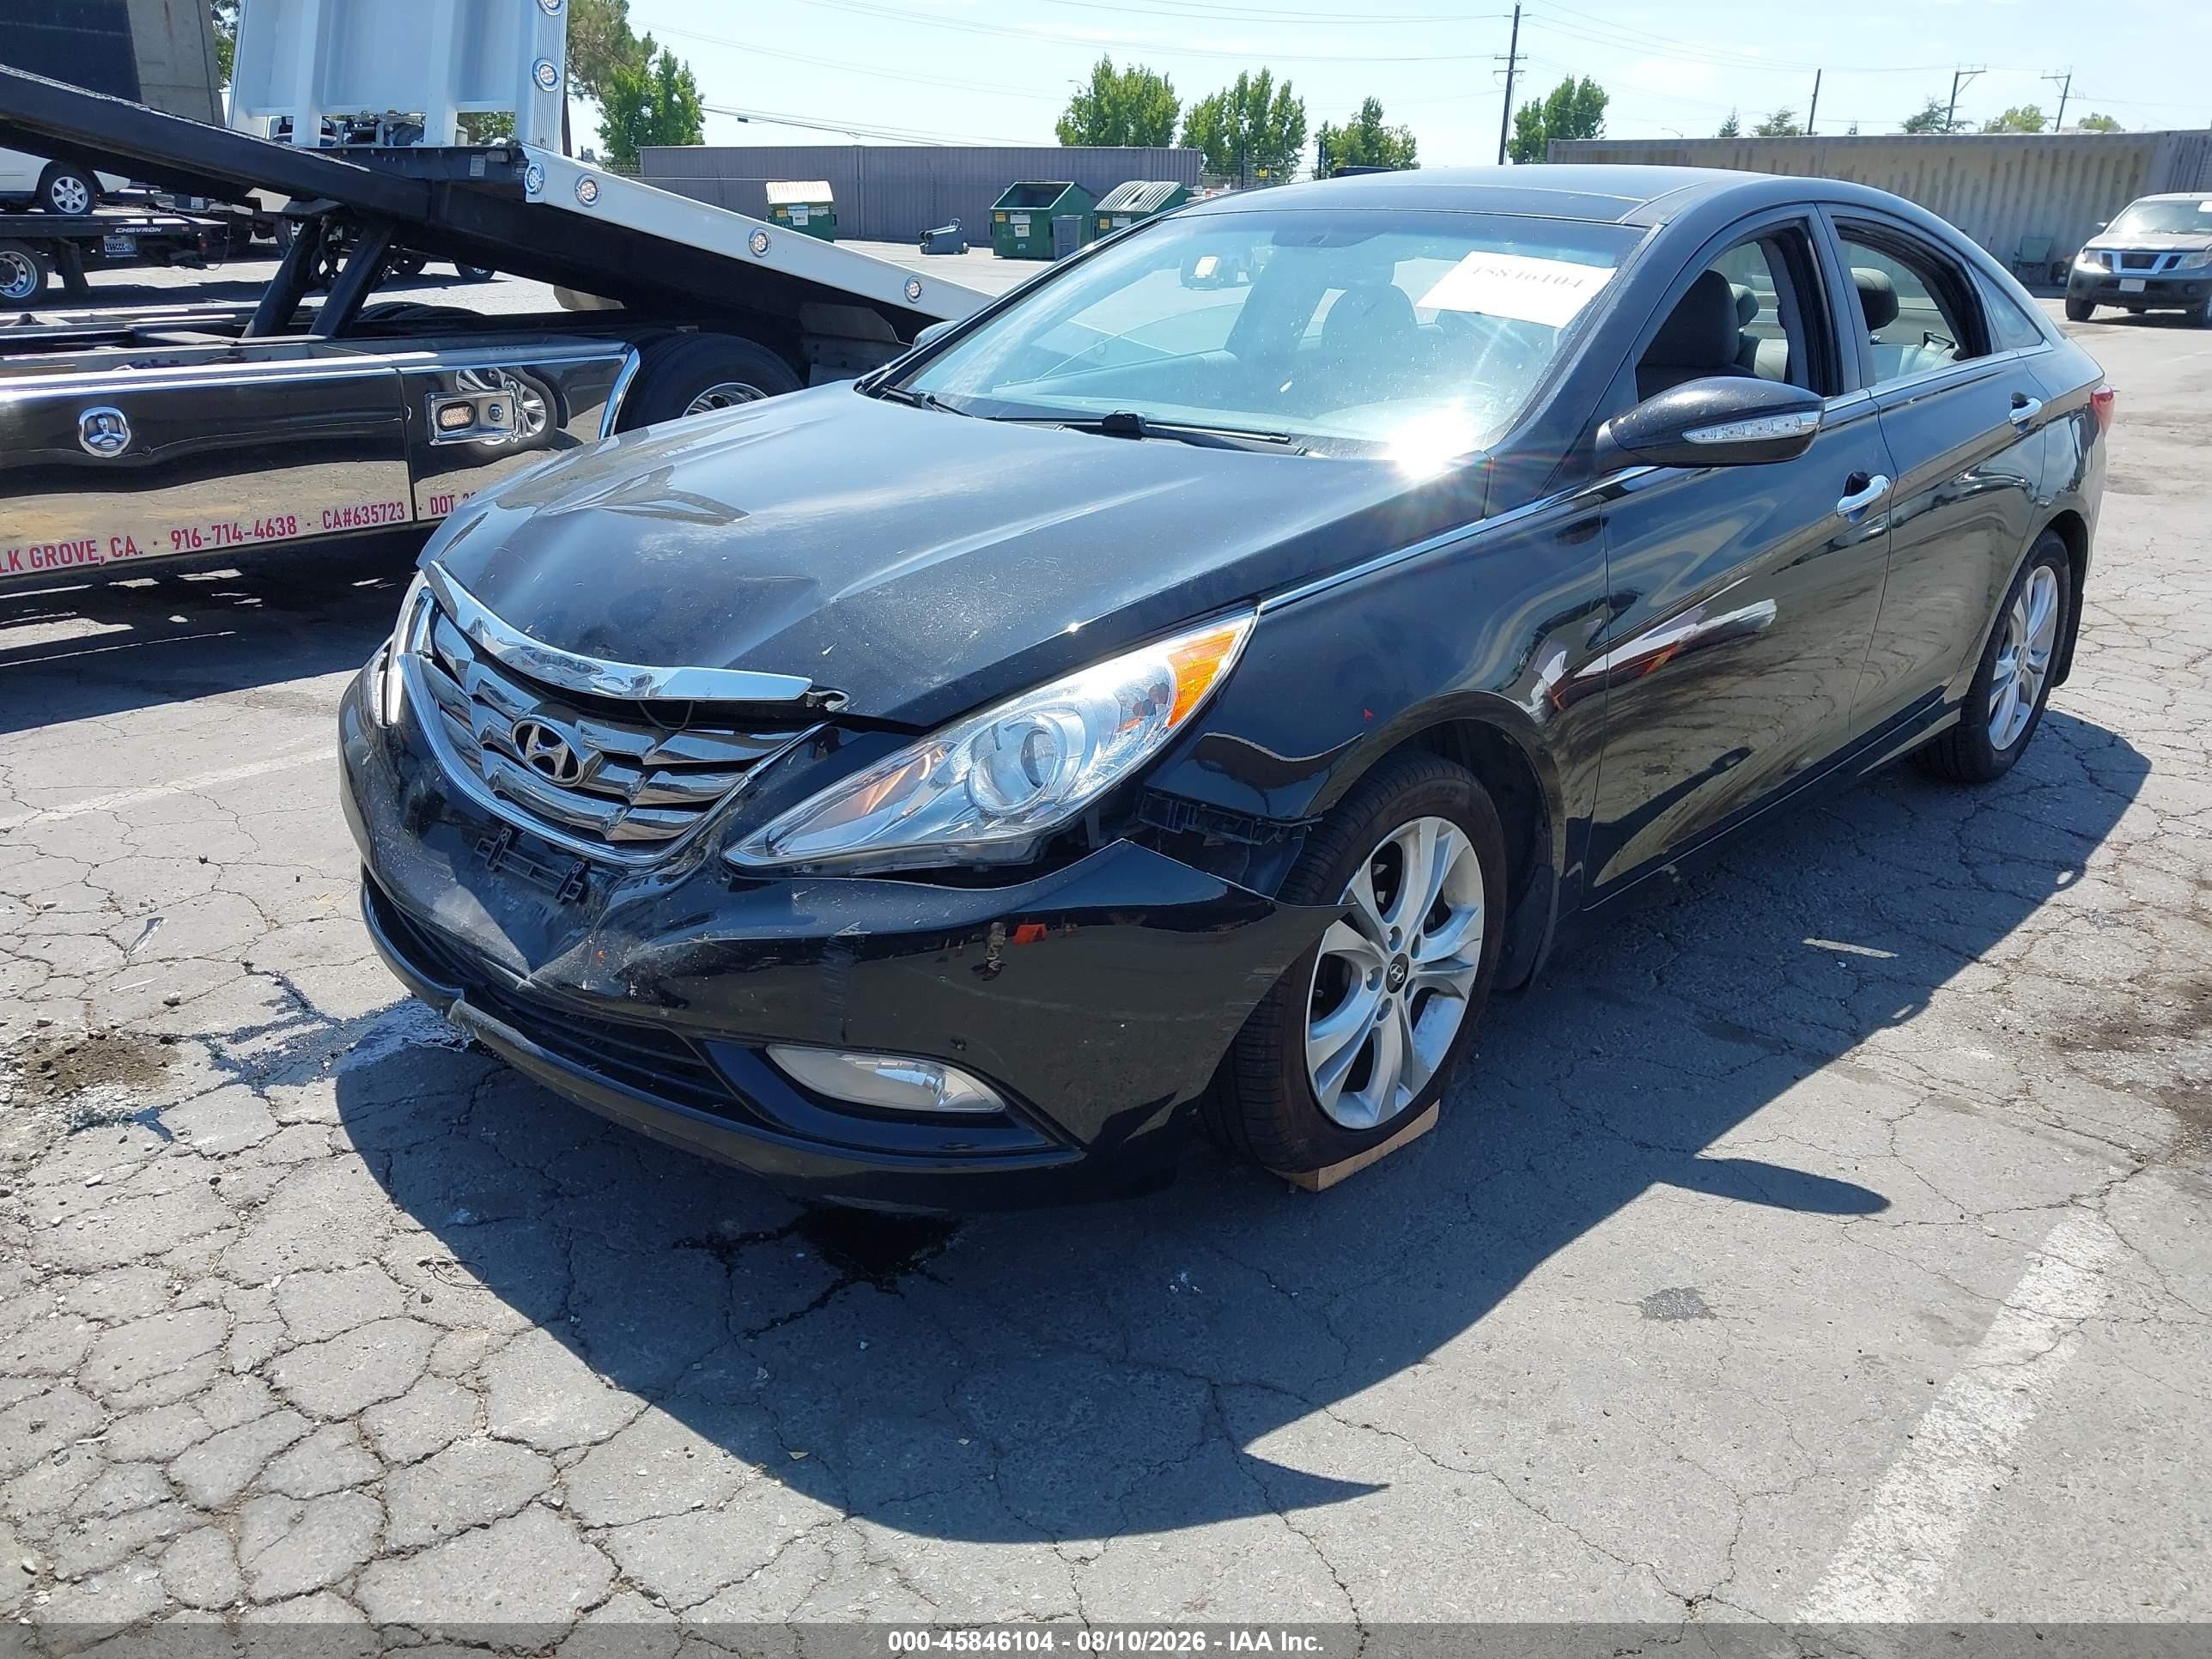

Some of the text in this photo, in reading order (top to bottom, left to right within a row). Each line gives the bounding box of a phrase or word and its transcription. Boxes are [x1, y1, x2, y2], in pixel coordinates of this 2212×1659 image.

[29, 540, 105, 568] GROVE,
[110, 535, 143, 558] CA.
[171, 515, 297, 550] 916-714-4638
[322, 501, 405, 530] CA#635723
[430, 494, 455, 515] DOT
